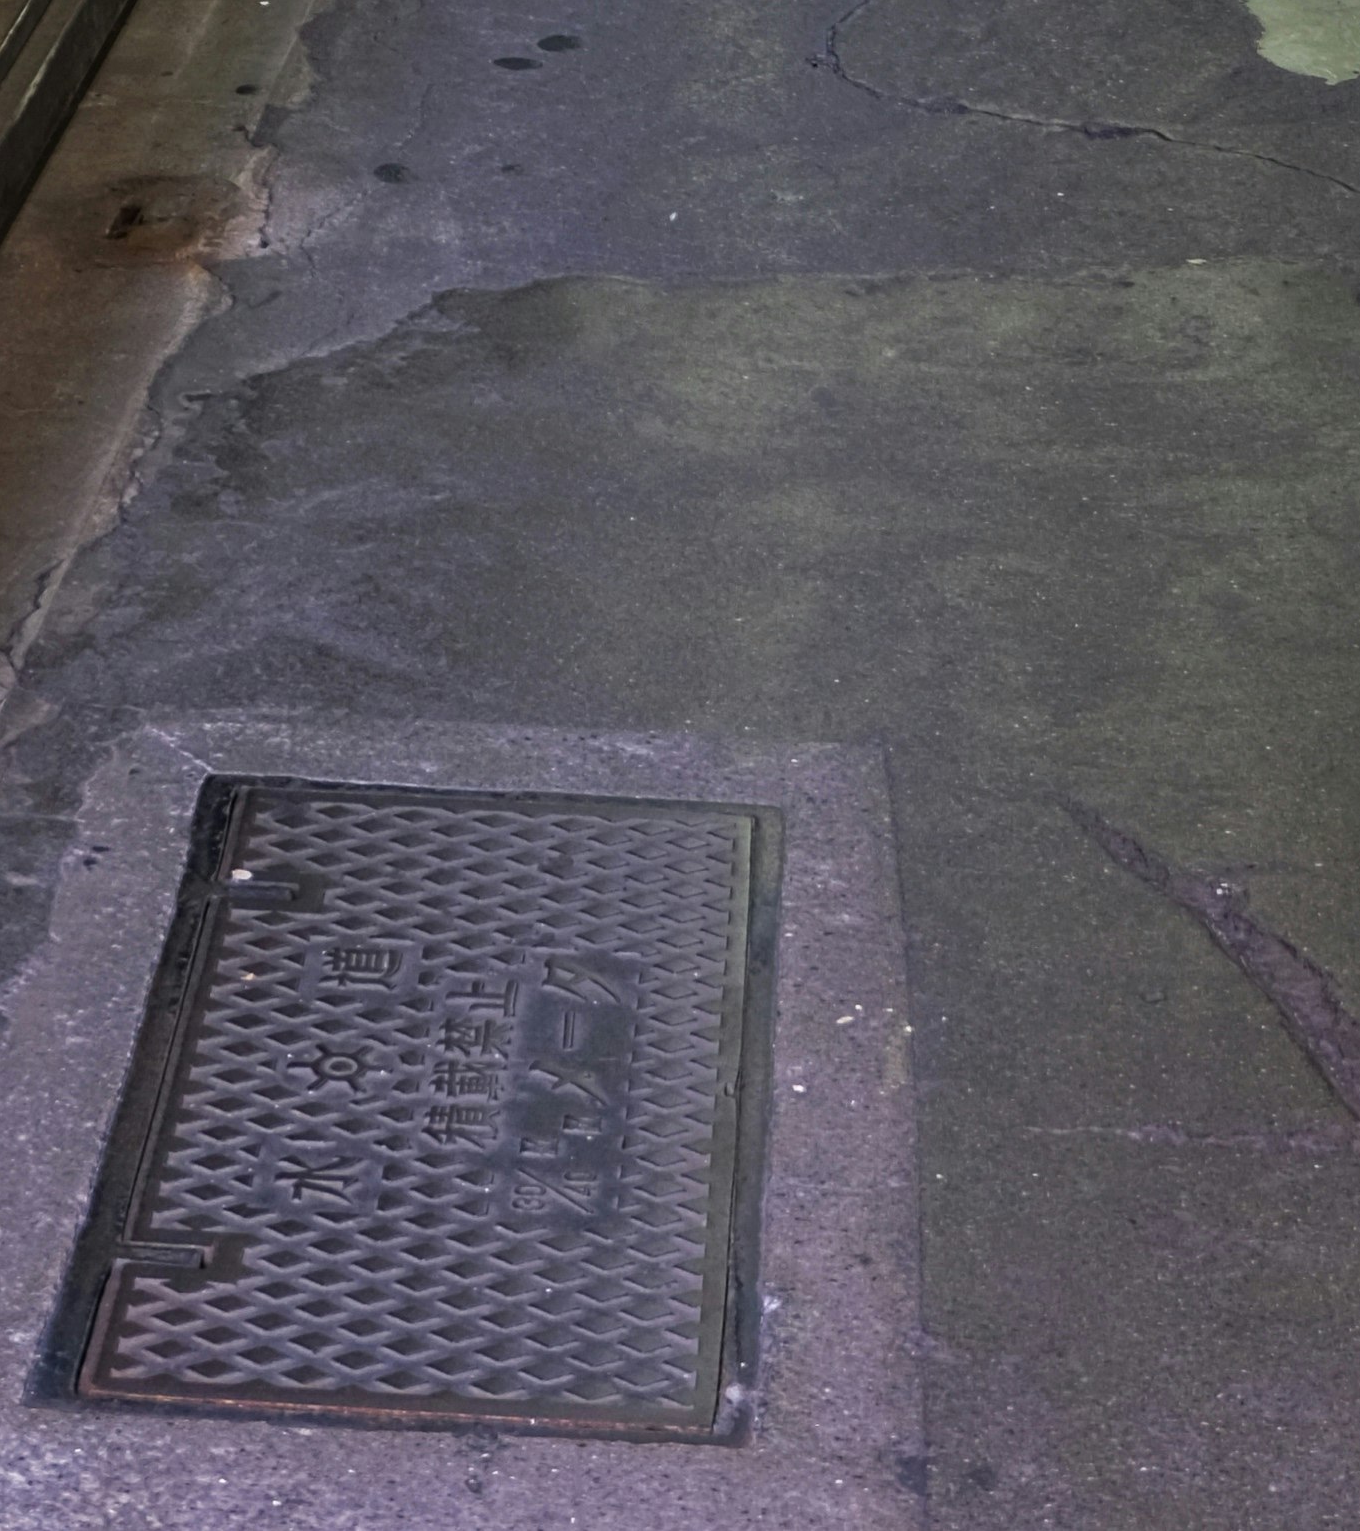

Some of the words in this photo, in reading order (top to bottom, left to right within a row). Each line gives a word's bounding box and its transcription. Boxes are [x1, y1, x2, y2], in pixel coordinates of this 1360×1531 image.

[318, 945, 405, 991] 道
[420, 980, 520, 1150] 積載禁止
[273, 1154, 365, 1205] 水
